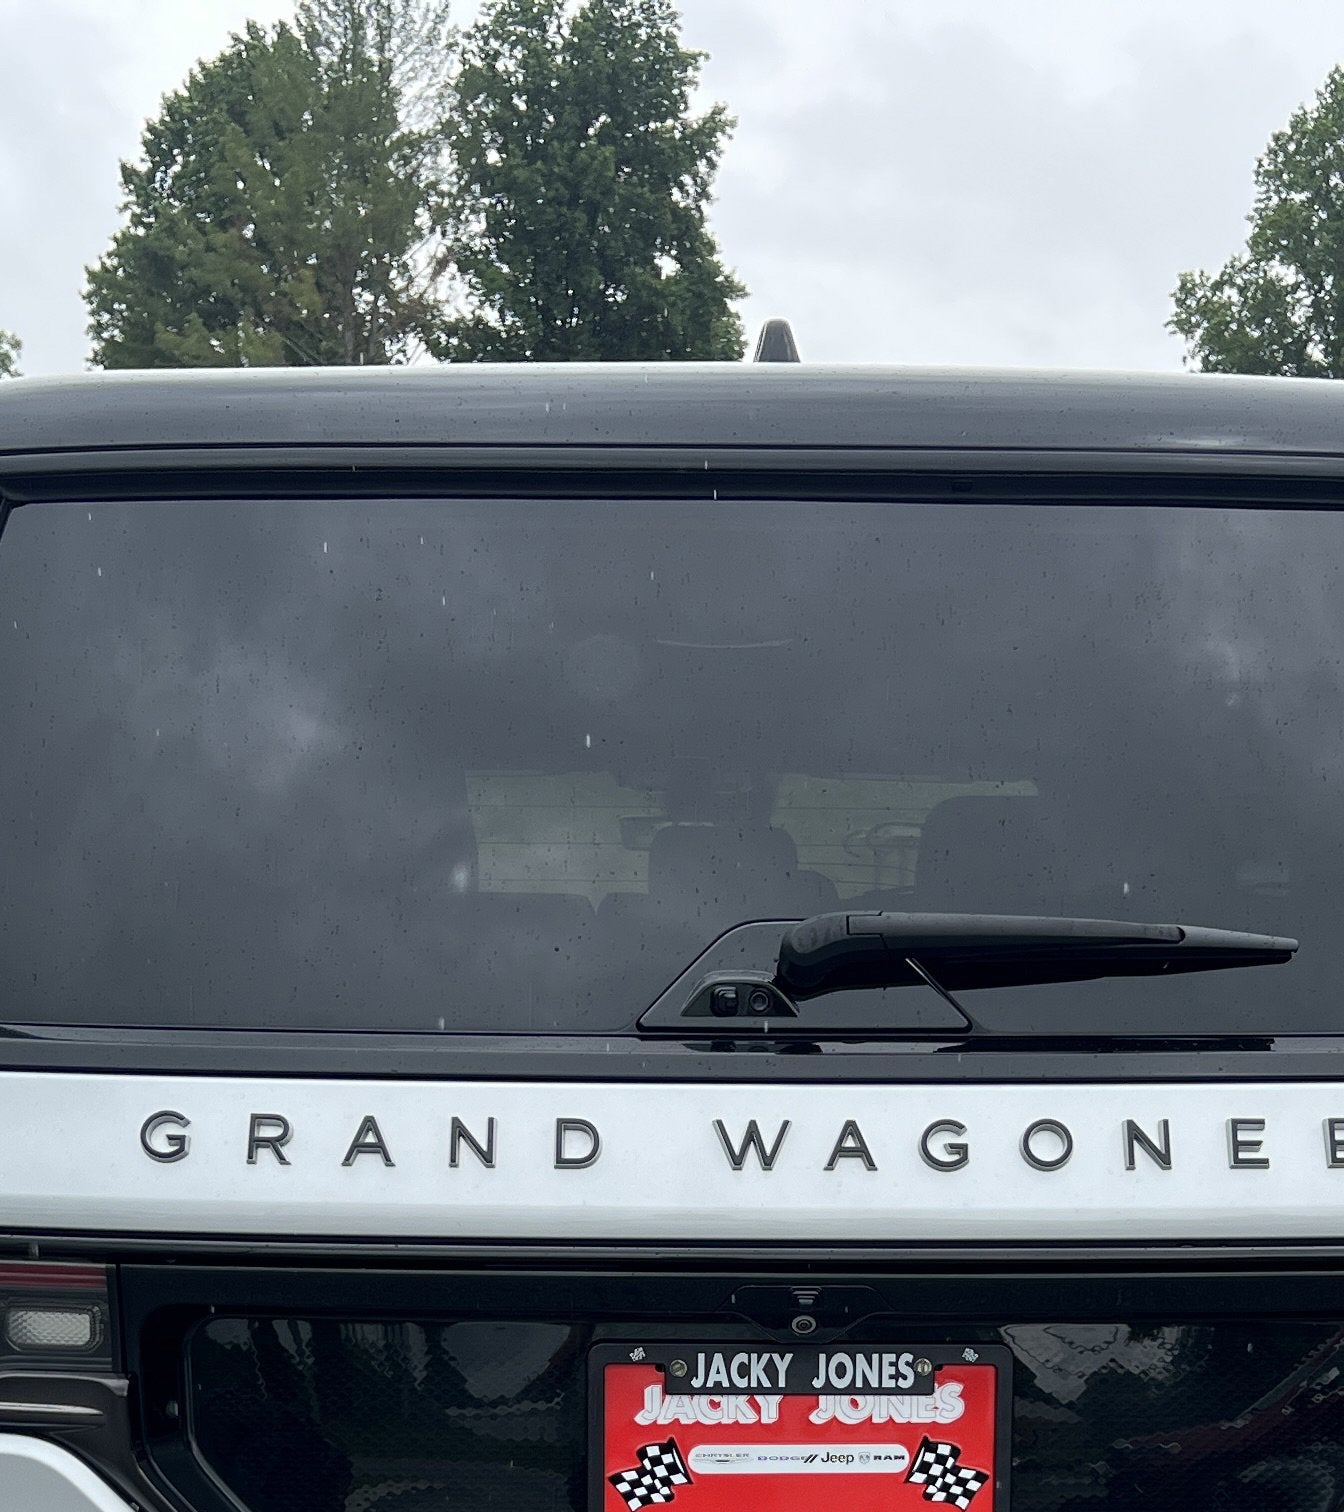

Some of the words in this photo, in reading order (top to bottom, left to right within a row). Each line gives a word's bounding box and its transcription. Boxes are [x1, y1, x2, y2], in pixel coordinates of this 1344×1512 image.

[140, 1109, 603, 1169] GRAND
[691, 1352, 794, 1389] JACKY
[811, 1352, 915, 1389] JONES
[634, 1384, 783, 1425] JACKY
[809, 1382, 966, 1424] JONES
[821, 1451, 854, 1465] Jeep
